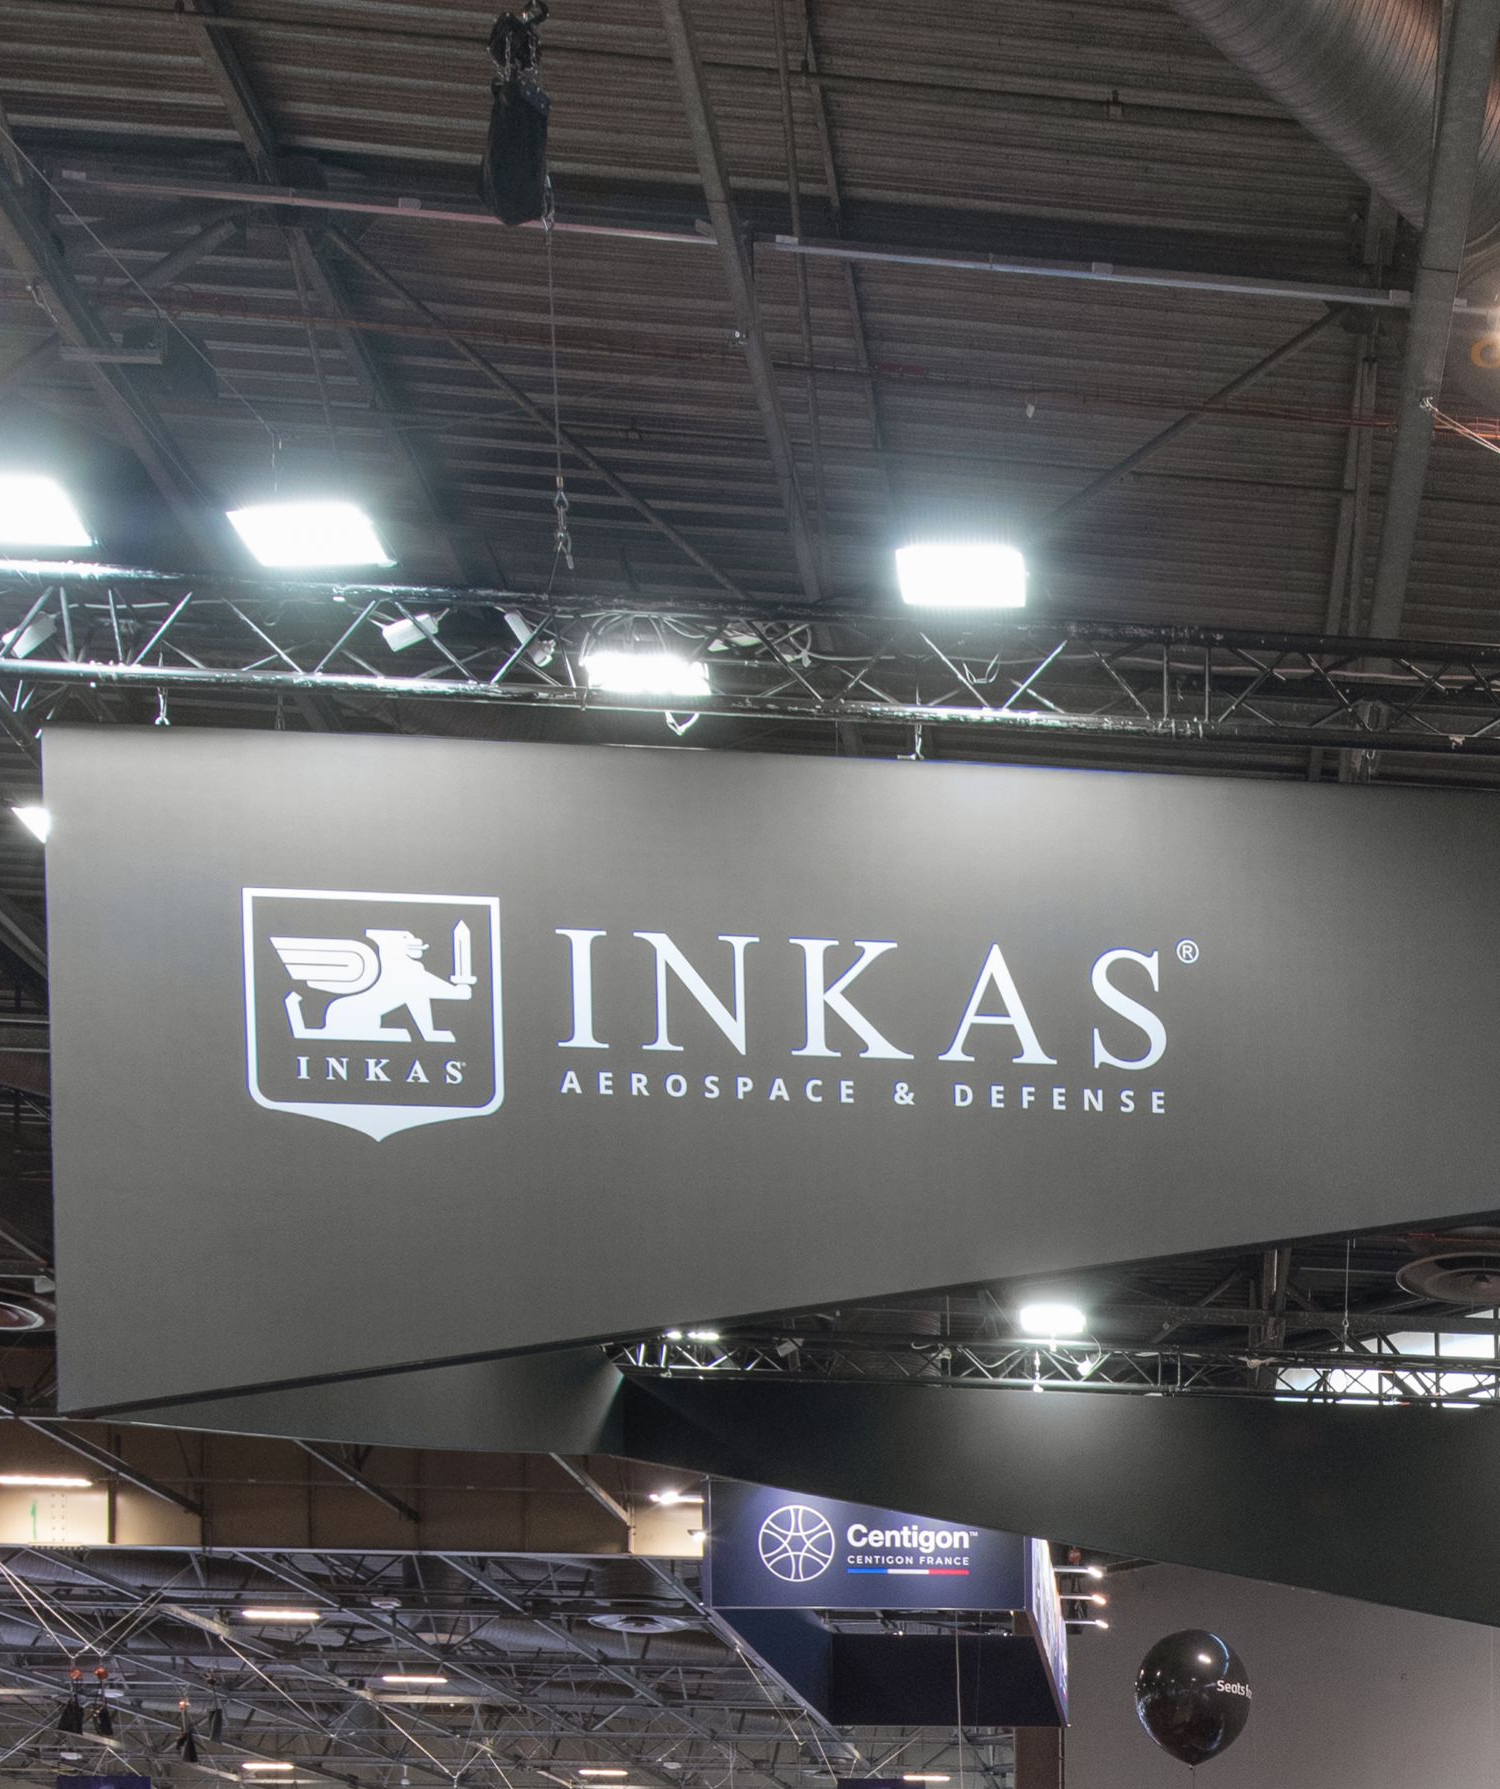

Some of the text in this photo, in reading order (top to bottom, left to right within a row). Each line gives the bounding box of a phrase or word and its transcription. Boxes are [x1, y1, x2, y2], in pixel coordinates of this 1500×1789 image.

[559, 1069, 1166, 1115] AEROSPACE & DEFENSE
[847, 1555, 970, 1566] CENTIGON FRANCE
